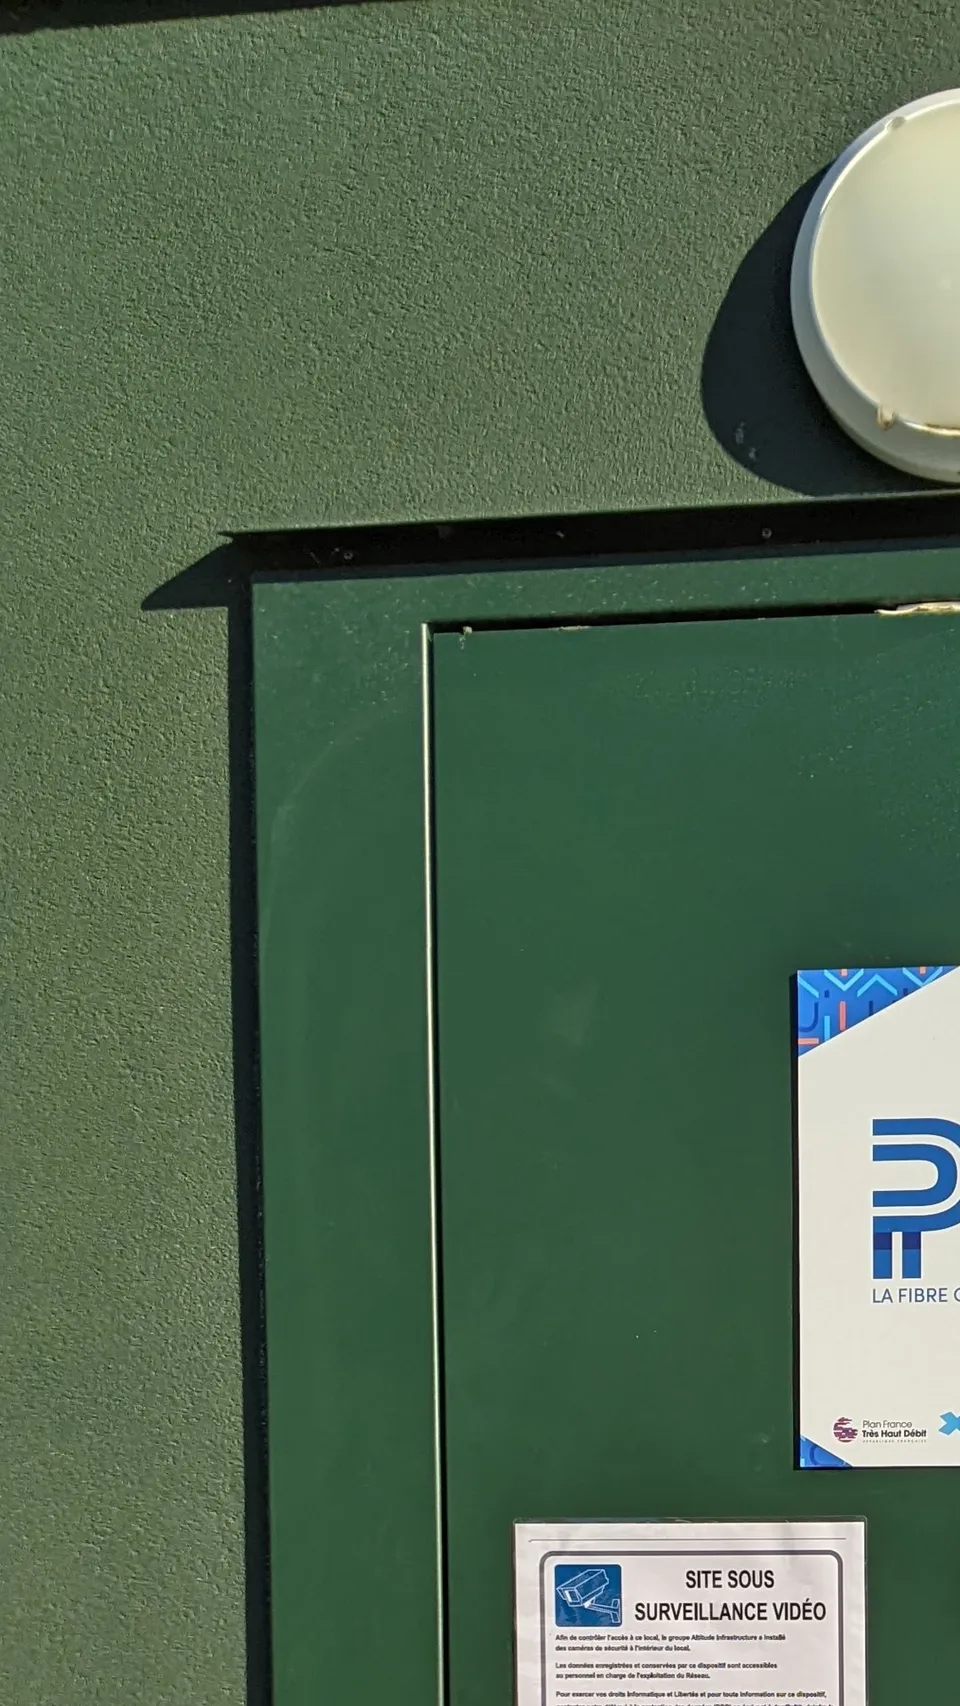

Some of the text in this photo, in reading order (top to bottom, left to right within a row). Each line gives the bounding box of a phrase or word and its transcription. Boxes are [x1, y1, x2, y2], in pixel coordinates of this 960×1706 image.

[872, 1288, 893, 1303] LA
[898, 1287, 948, 1302] FIBRE
[862, 1419, 912, 1428] Plan France
[861, 1428, 926, 1437] Très Haut Débit
[685, 1569, 774, 1588] SITE SOUS
[634, 1597, 826, 1620] SURVEILLANCE VIDÉO
[636, 1671, 675, 1679] l'exploitation
